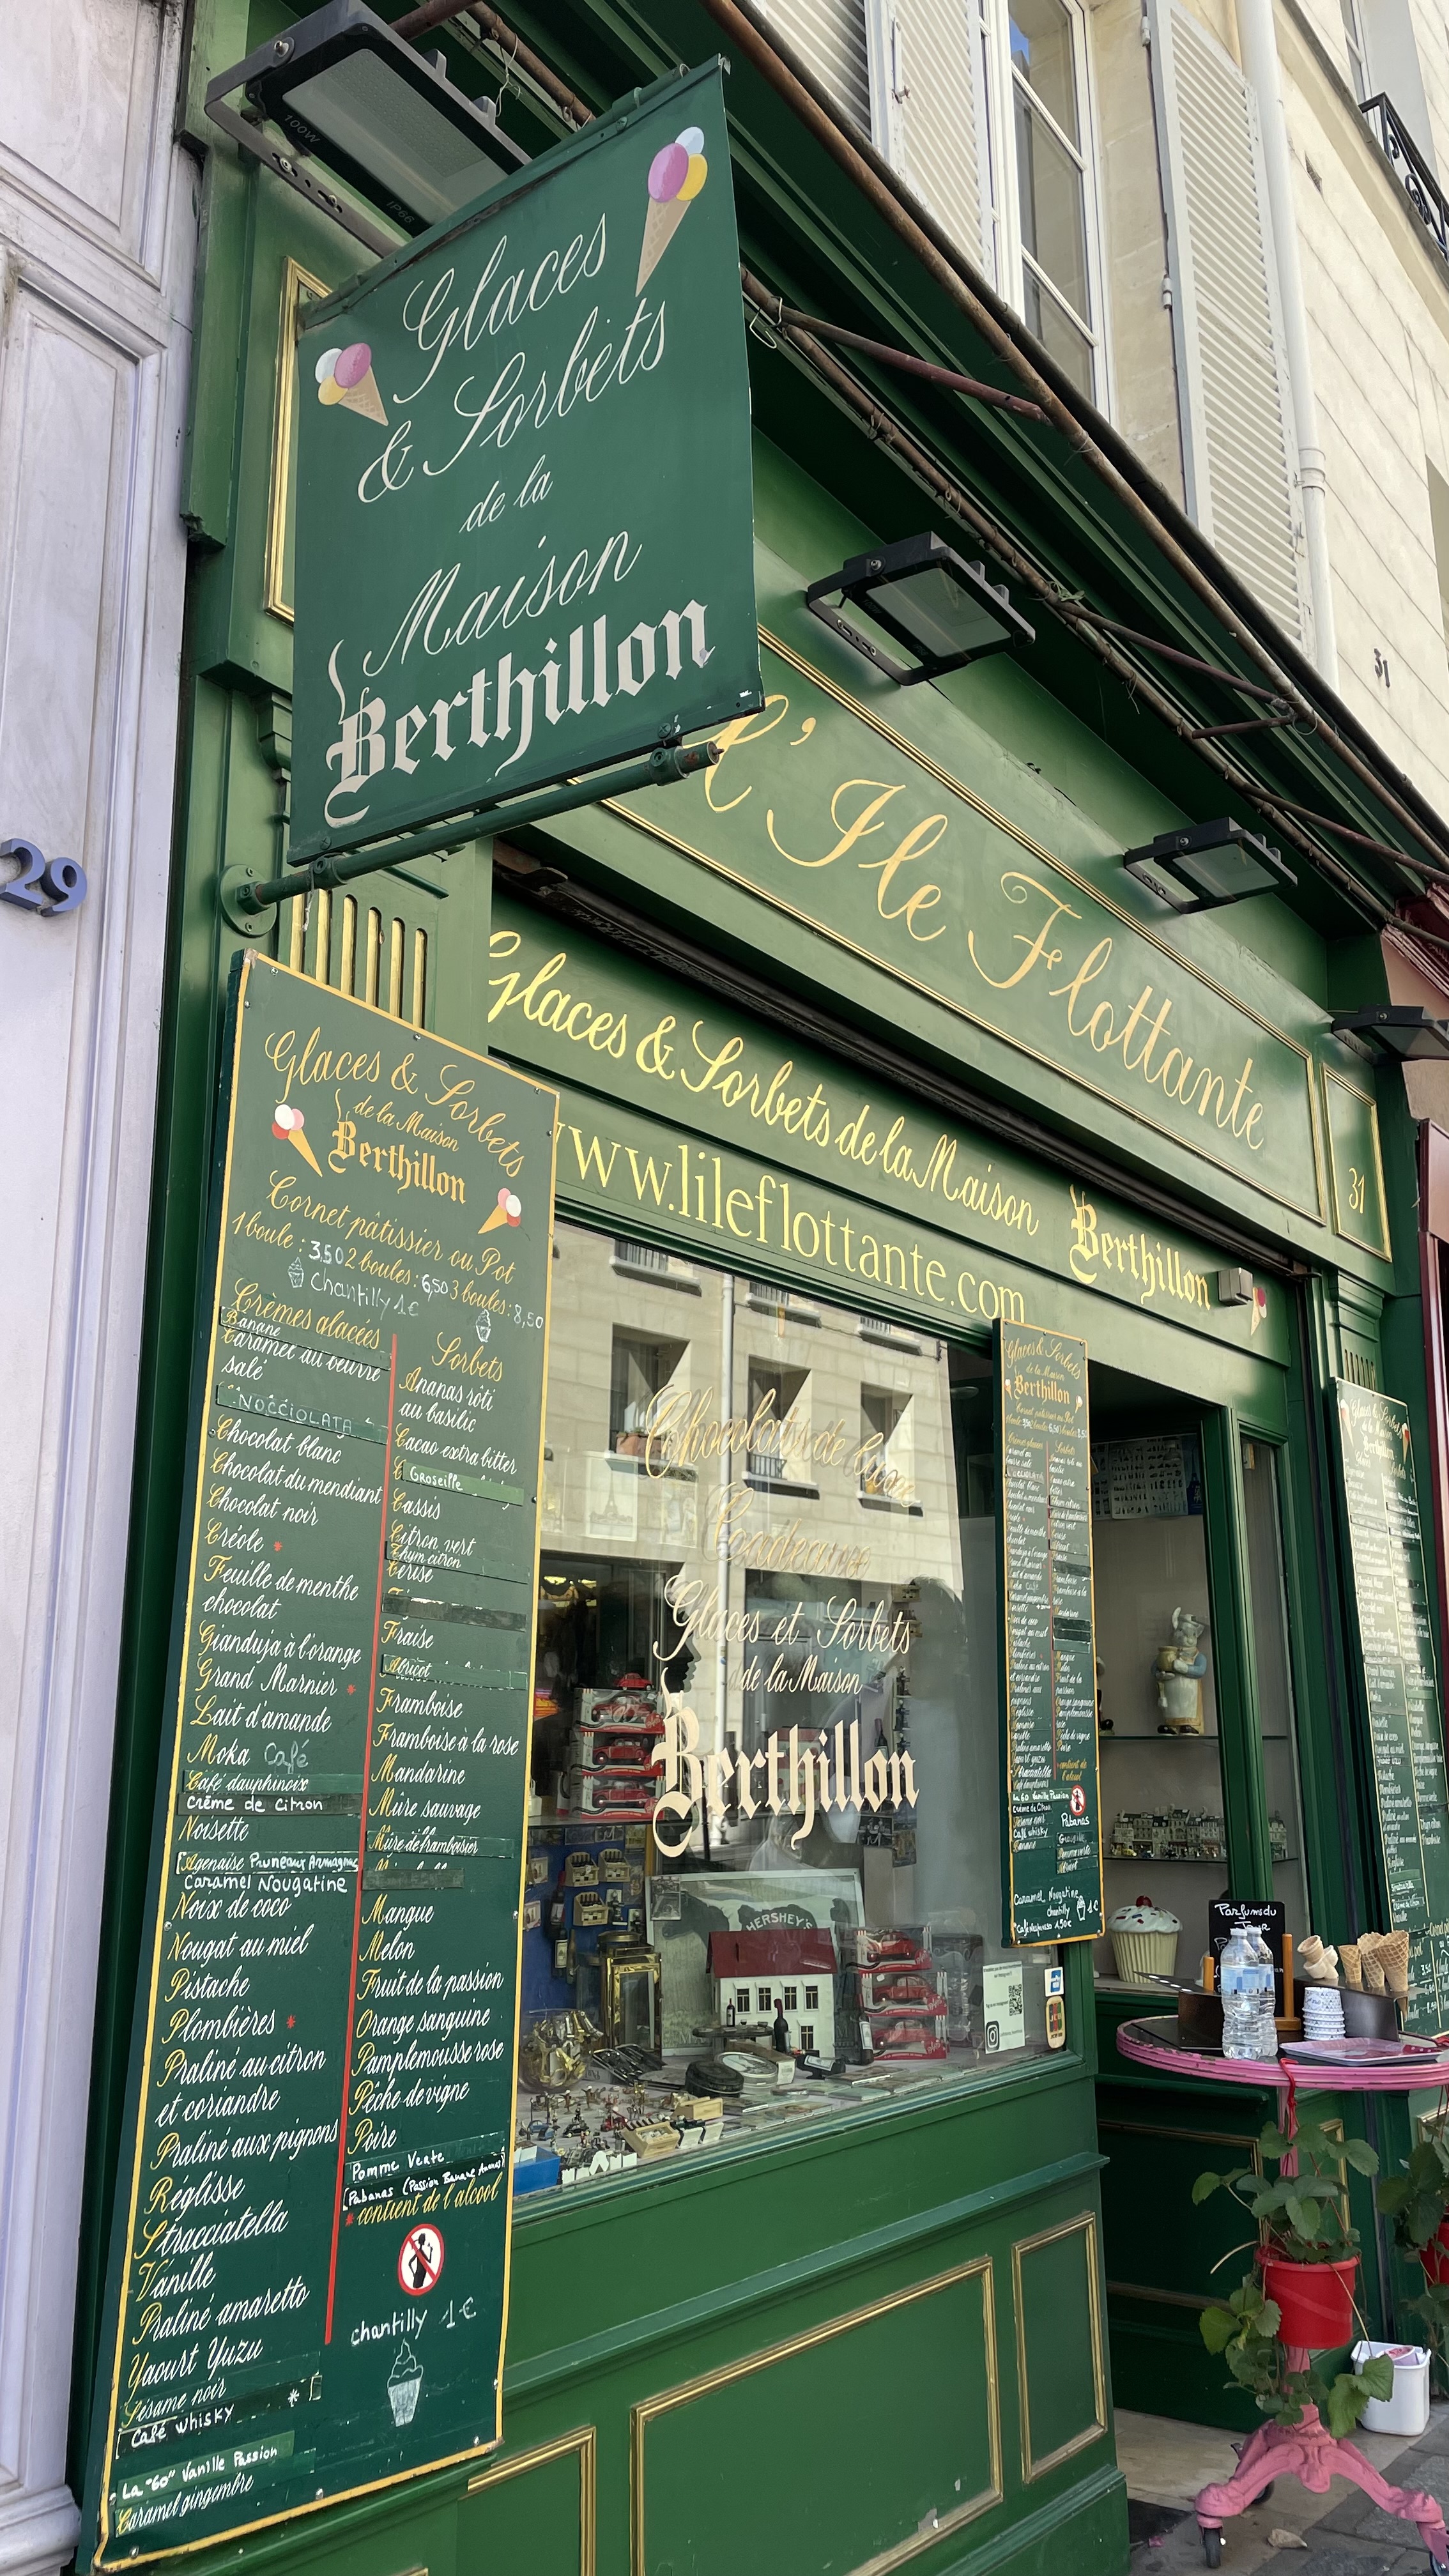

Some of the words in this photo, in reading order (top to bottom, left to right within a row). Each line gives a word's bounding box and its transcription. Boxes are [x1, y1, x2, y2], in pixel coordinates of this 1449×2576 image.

[284, 114, 321, 142] 100W
[387, 201, 415, 223] IP66
[394, 213, 607, 403] Glaces
[358, 420, 413, 503] &
[423, 298, 667, 476] Sorbets
[459, 480, 505, 533] de
[514, 454, 553, 508] la
[363, 531, 642, 676] Maison
[324, 599, 716, 829] Berthillon
[0, 838, 87, 916] 29
[968, 871, 1264, 1149] Flottante
[264, 1027, 381, 1103] Glaces
[390, 1053, 418, 1094] &
[425, 1064, 525, 1177] Sorbets
[353, 1095, 375, 1117] de
[376, 1101, 394, 1126] la
[396, 1111, 459, 1152] Maison
[328, 1089, 466, 1204] Berthillon
[636, 1015, 675, 1080] &
[681, 1020, 831, 1147] Sorbets
[835, 1105, 877, 1165] de
[879, 1116, 913, 1181] la
[912, 1133, 1039, 1236] Maison
[1070, 1184, 1211, 1310] Berthillon
[1348, 1168, 1365, 1214] 31
[266, 1170, 351, 1228] Cornet
[345, 1211, 443, 1261] pâtissier
[475, 1248, 516, 1284] Pot
[556, 1122, 1024, 1322] ww.lileflottante.com
[223, 1310, 280, 1337] Banane
[231, 1278, 312, 1330] Crèmes
[316, 1310, 380, 1349] glacées
[220, 1327, 296, 1360] Caramel
[432, 1332, 503, 1381] Sorbets
[1005, 1338, 1034, 1368] Glaces
[1036, 1337, 1043, 1355] &
[1045, 1338, 1081, 1379] Sorbets
[221, 1356, 267, 1380] salé
[1014, 1365, 1070, 1405] Berthillon
[399, 1367, 463, 1403] Ananas
[466, 1385, 495, 1411] rôti
[426, 1402, 476, 1432] basilic
[645, 1384, 810, 1478] Chocolats
[815, 1419, 846, 1466] de
[217, 1414, 294, 1453] Chocolat
[296, 1435, 342, 1464] blanc
[395, 1423, 438, 1455] Cacao
[441, 1444, 478, 1466] extra
[481, 1447, 517, 1474] bitter
[307, 1478, 383, 1504] mendiant
[392, 1488, 440, 1519] Cassis
[282, 1501, 319, 1526] noir
[204, 1517, 264, 1552] Créole
[388, 1519, 438, 1550] Citron
[444, 1538, 476, 1556] vert
[387, 1560, 434, 1583] Cerise
[390, 1544, 425, 1563] Thym
[427, 1551, 461, 1568] citron
[204, 1555, 272, 1589] Feuille
[296, 1575, 358, 1600] menthe
[202, 1587, 281, 1619] chocolat
[653, 1574, 760, 1660] Glaces
[771, 1602, 804, 1645] et
[816, 1596, 910, 1654] Sorbets
[198, 1620, 281, 1664] Gianduja
[298, 1633, 361, 1670] l'orange
[381, 1620, 434, 1648] Fraise
[195, 1656, 255, 1691] Grand
[261, 1662, 337, 1696] Marnier
[385, 1657, 432, 1678] Abricot
[740, 1655, 759, 1690] de
[765, 1653, 786, 1693] la
[787, 1654, 862, 1695] Maison
[190, 1695, 245, 1726] Lait
[245, 1701, 332, 1733] d'amande
[376, 1687, 463, 1718] Framboise
[188, 1733, 250, 1766] Moka
[489, 1735, 519, 1756] rose
[652, 1667, 919, 1857] Berthillon
[371, 1753, 465, 1784] Mandarine
[369, 1787, 418, 1817] Mûre
[420, 1800, 481, 1825] sauvage
[178, 1815, 249, 1841] Noisette
[419, 1835, 479, 1854] framboisier
[181, 1853, 244, 1874] Agenaise
[172, 1890, 223, 1920] Noix
[251, 1897, 291, 1916] coco
[258, 1876, 348, 1897] Nougatine
[362, 1894, 434, 1930] Mangue
[1264, 1905, 1276, 1915] du
[167, 1932, 238, 1968] Nougat
[266, 1924, 314, 1956] miel
[359, 1930, 415, 1961] Melon
[165, 1965, 250, 2001] Pistache
[357, 1968, 407, 2000] Fruit
[443, 1962, 503, 2000] passion
[162, 2005, 275, 2044] Plombières
[356, 2009, 414, 2044] Orange
[416, 1998, 490, 2041] sanguine
[157, 2047, 240, 2087] Praliné
[351, 2039, 472, 2079] Pamplemousse
[182, 2083, 280, 2122] coriandre
[349, 2078, 401, 2115] Pêche
[426, 2074, 470, 2113] vigne
[269, 2118, 339, 2161] pignons
[348, 2119, 397, 2154] Poire
[353, 2162, 399, 2181] Pomme
[144, 2171, 245, 2221] Réglisse
[357, 2192, 420, 2226] contient
[134, 2200, 289, 2260] Stracciatella
[136, 2251, 215, 2302] Vanille
[215, 2276, 310, 2326] amaretto
[128, 2343, 199, 2402] Yaourt
[207, 2336, 264, 2380] Yuzu
[122, 2482, 143, 2499] La
[180, 2472, 254, 2517] gingembre
